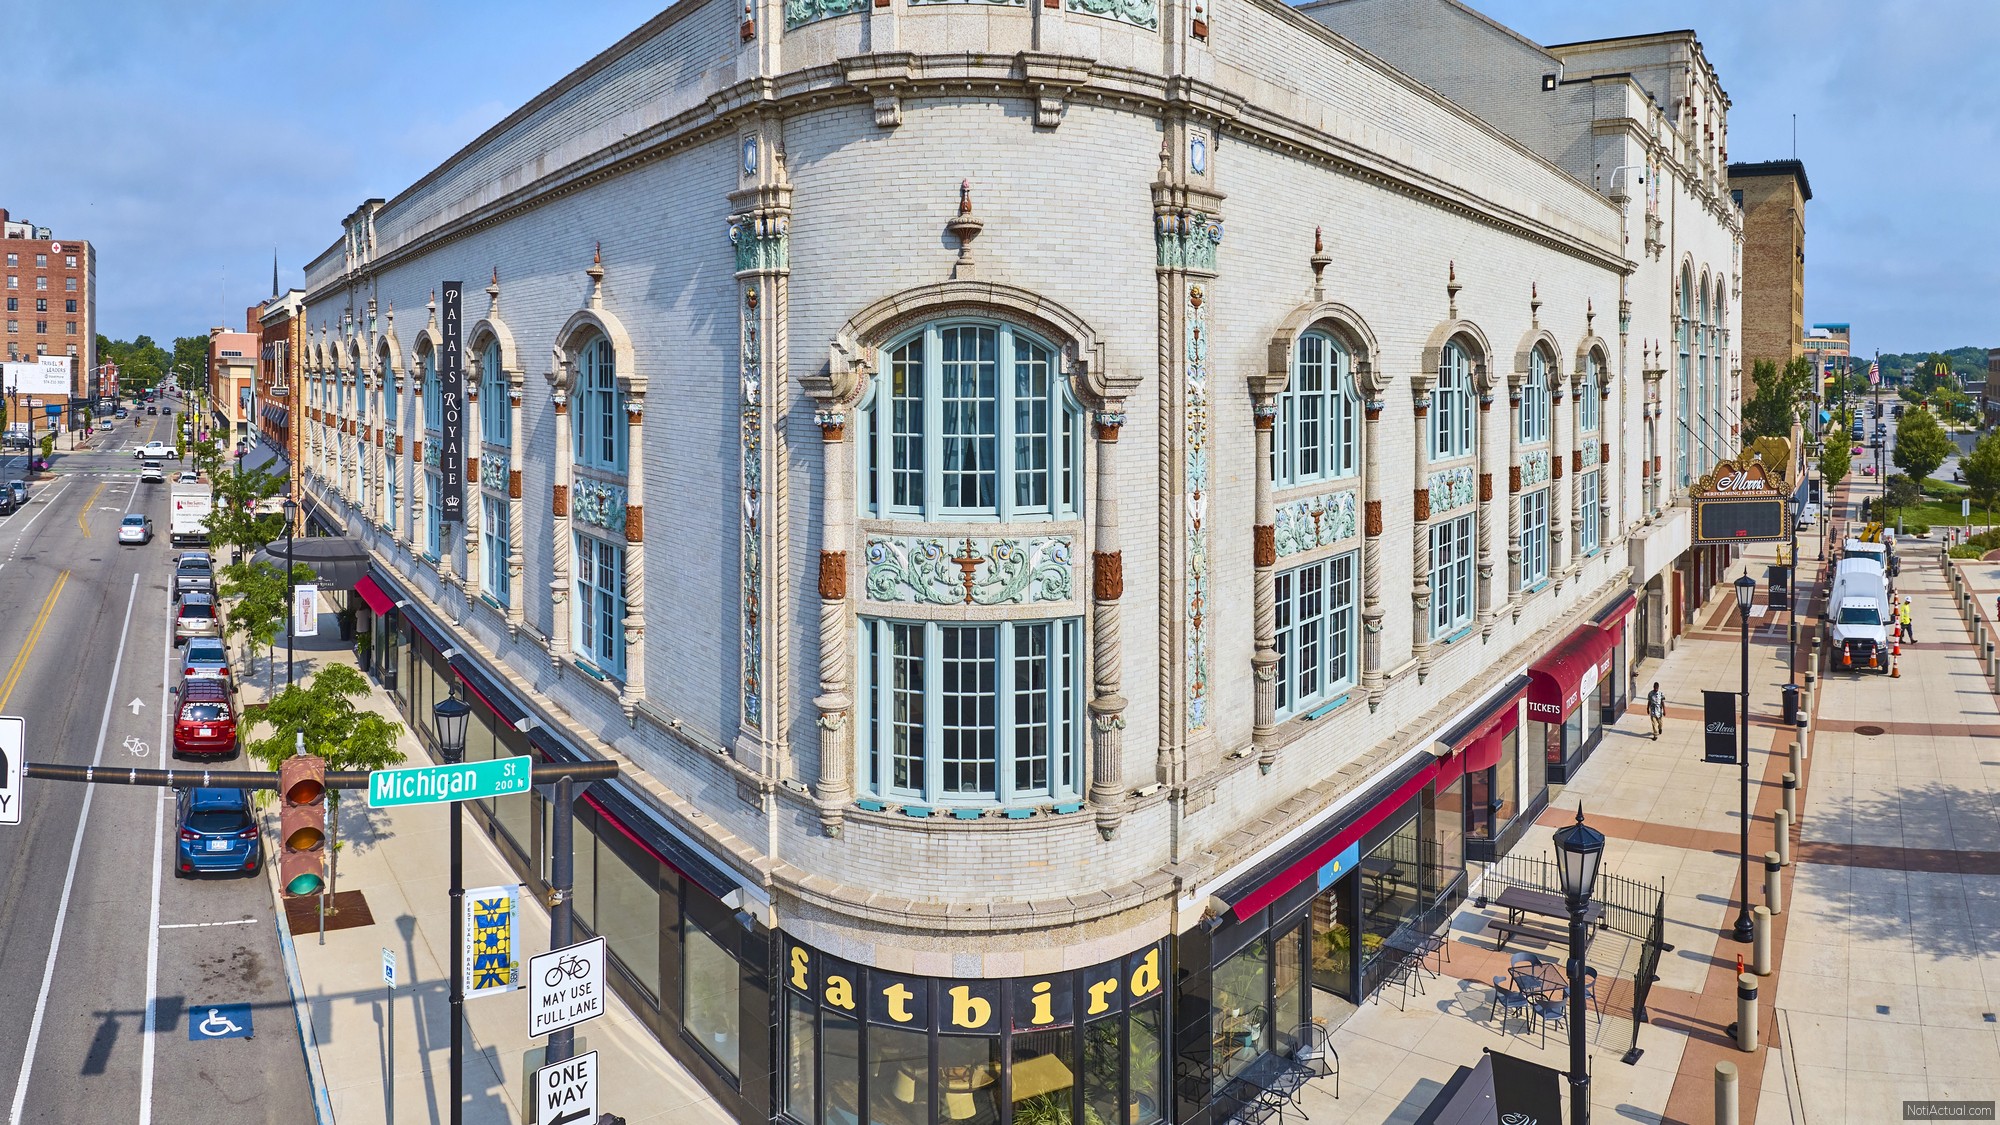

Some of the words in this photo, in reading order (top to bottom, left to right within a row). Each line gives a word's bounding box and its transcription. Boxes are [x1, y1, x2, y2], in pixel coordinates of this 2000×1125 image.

[445, 289, 458, 384] PALAIS
[444, 392, 460, 485] ROYALE
[1716, 470, 1766, 491] Morris
[1529, 702, 1560, 714] TICKETS
[376, 769, 477, 800] Michigan
[503, 763, 516, 777] St
[495, 780, 513, 791] 200
[518, 778, 524, 788] N
[466, 944, 471, 954] OF
[543, 990, 566, 1008] MAY
[571, 982, 592, 999] USE
[537, 1009, 565, 1027] FULL
[570, 998, 598, 1017] LANE
[549, 1061, 588, 1088] ONE
[548, 1081, 588, 1110] WAY
